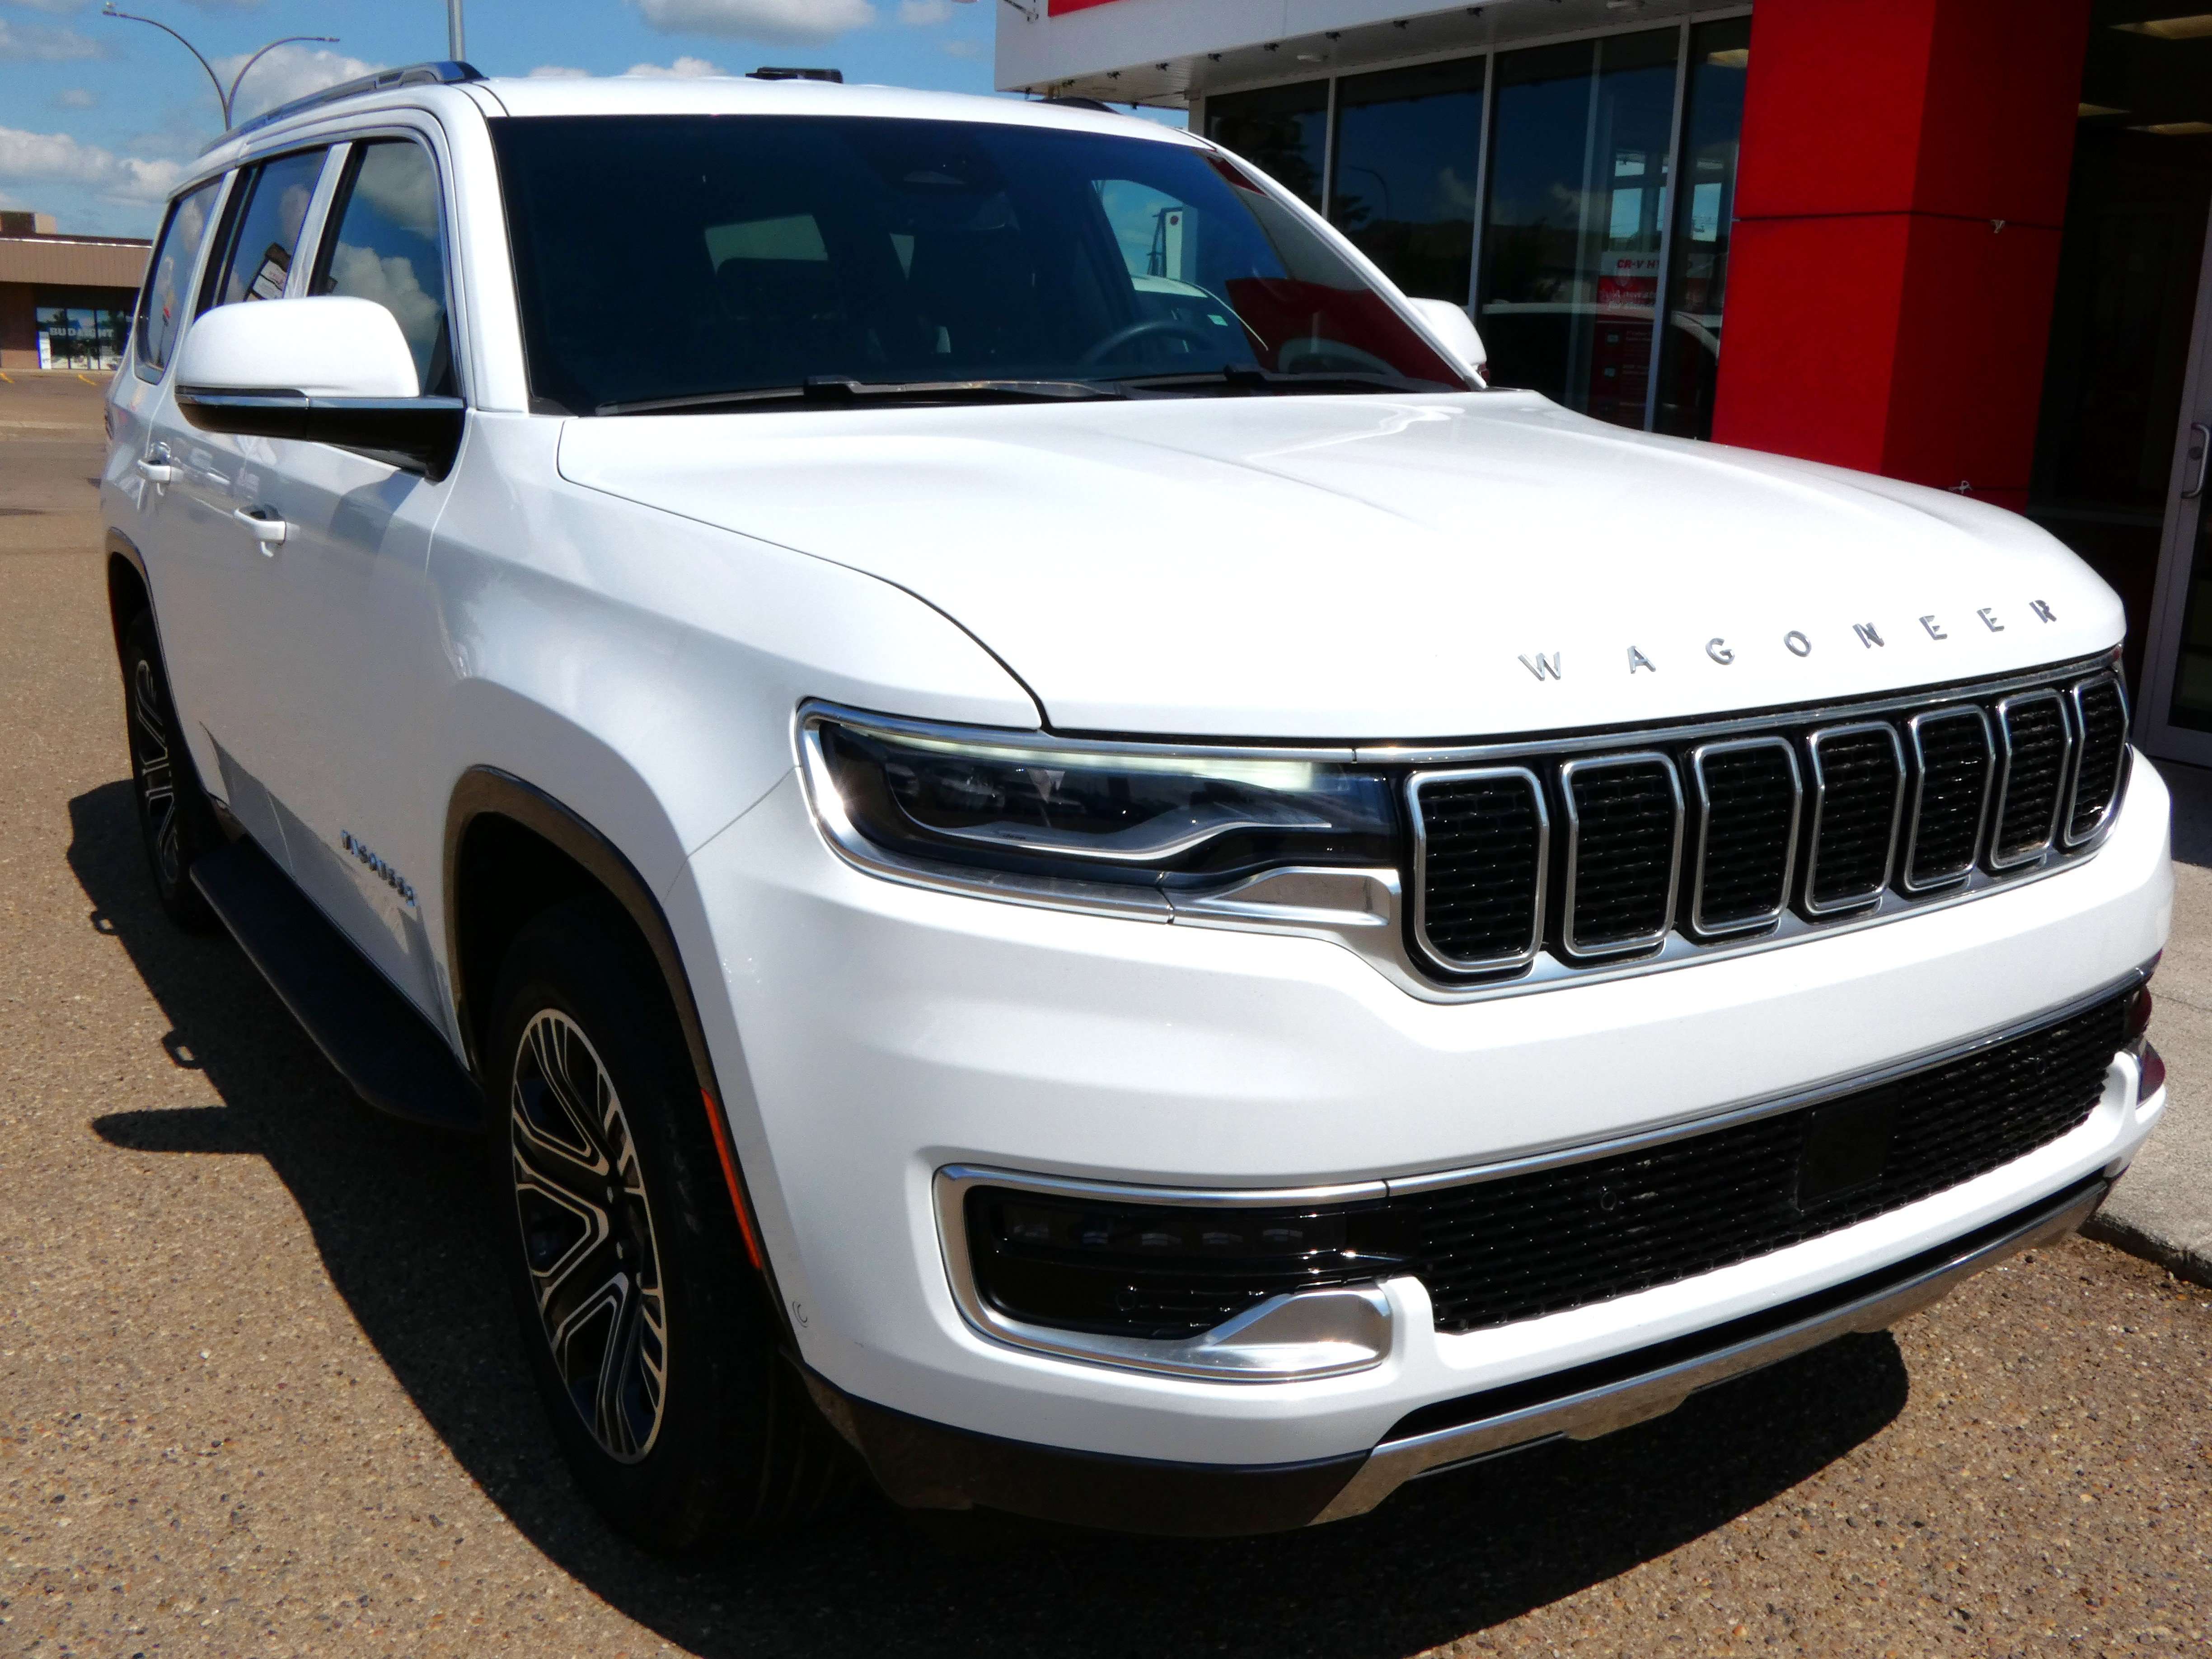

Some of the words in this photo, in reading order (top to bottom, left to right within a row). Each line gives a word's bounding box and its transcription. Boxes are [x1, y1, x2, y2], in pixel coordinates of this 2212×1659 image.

[1617, 259, 1642, 268] CR-V
[49, 327, 75, 336] BUD
[1518, 600, 2057, 681] WAGONEER
